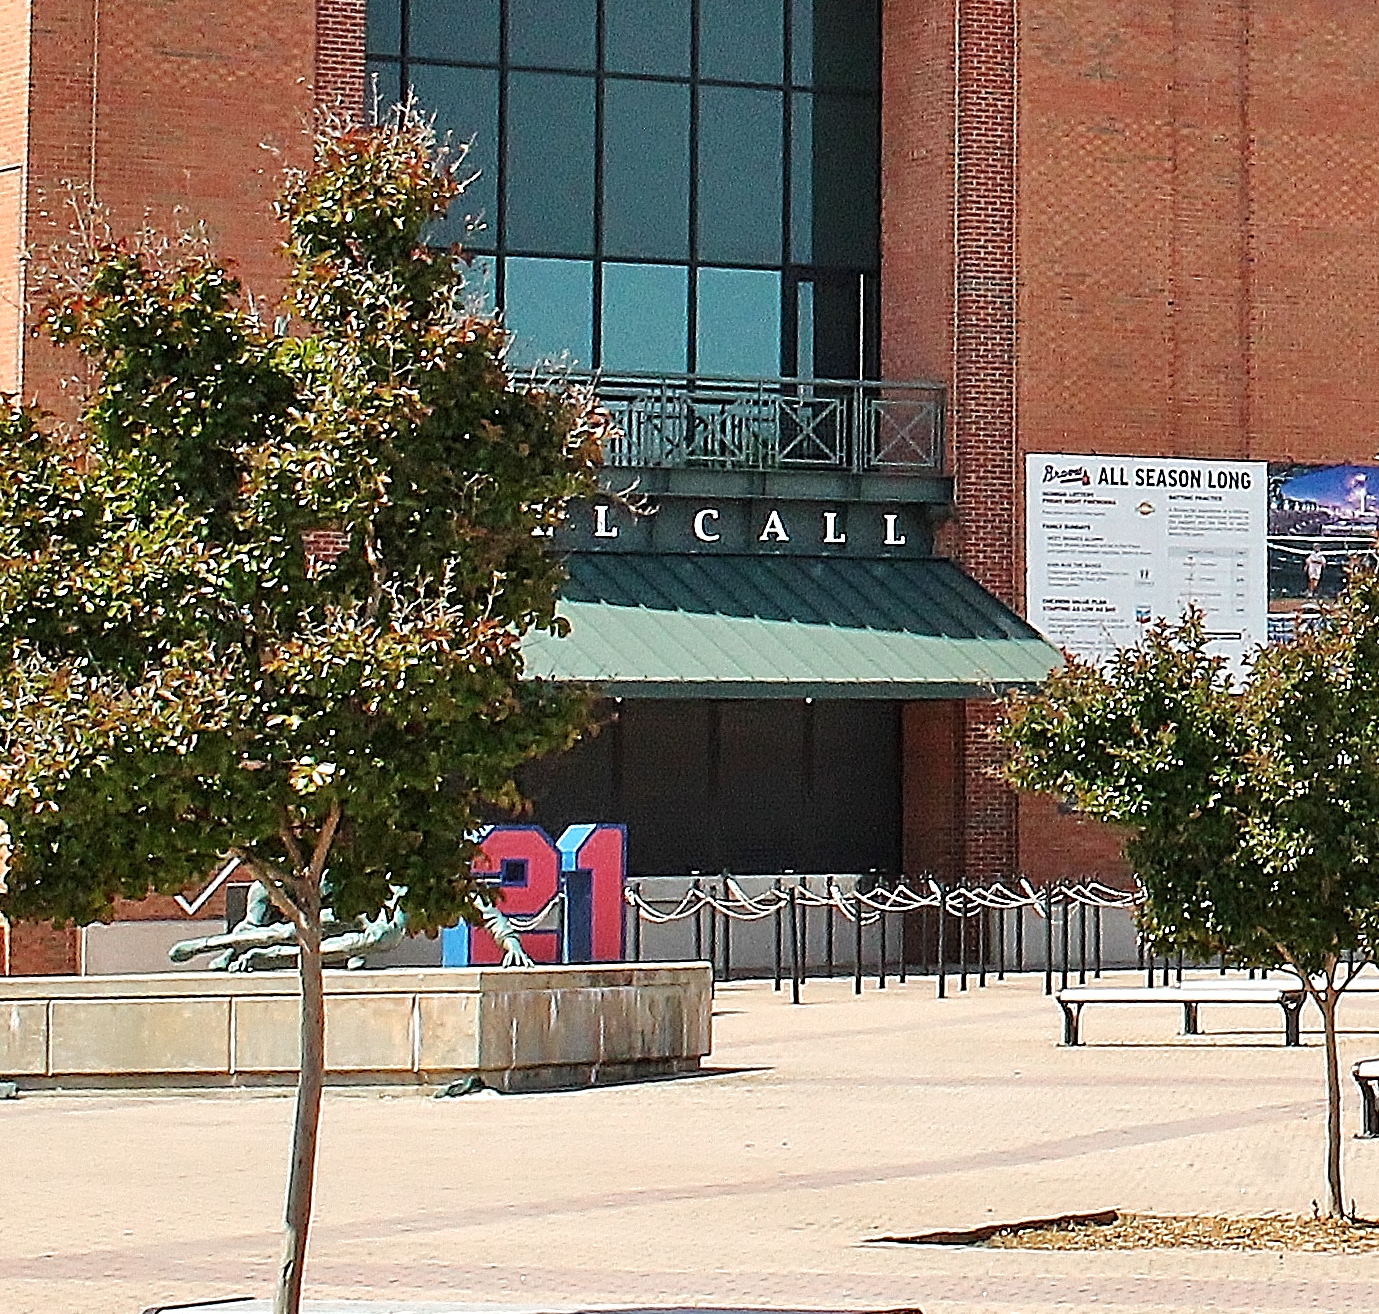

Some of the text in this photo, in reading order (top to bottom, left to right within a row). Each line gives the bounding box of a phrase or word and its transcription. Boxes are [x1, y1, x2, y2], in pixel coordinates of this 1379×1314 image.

[1098, 467, 1128, 486] ALL
[1135, 468, 1200, 488] SEASON
[1208, 470, 1251, 489] LONG
[694, 508, 906, 545] CALL
[444, 823, 628, 967] 21
